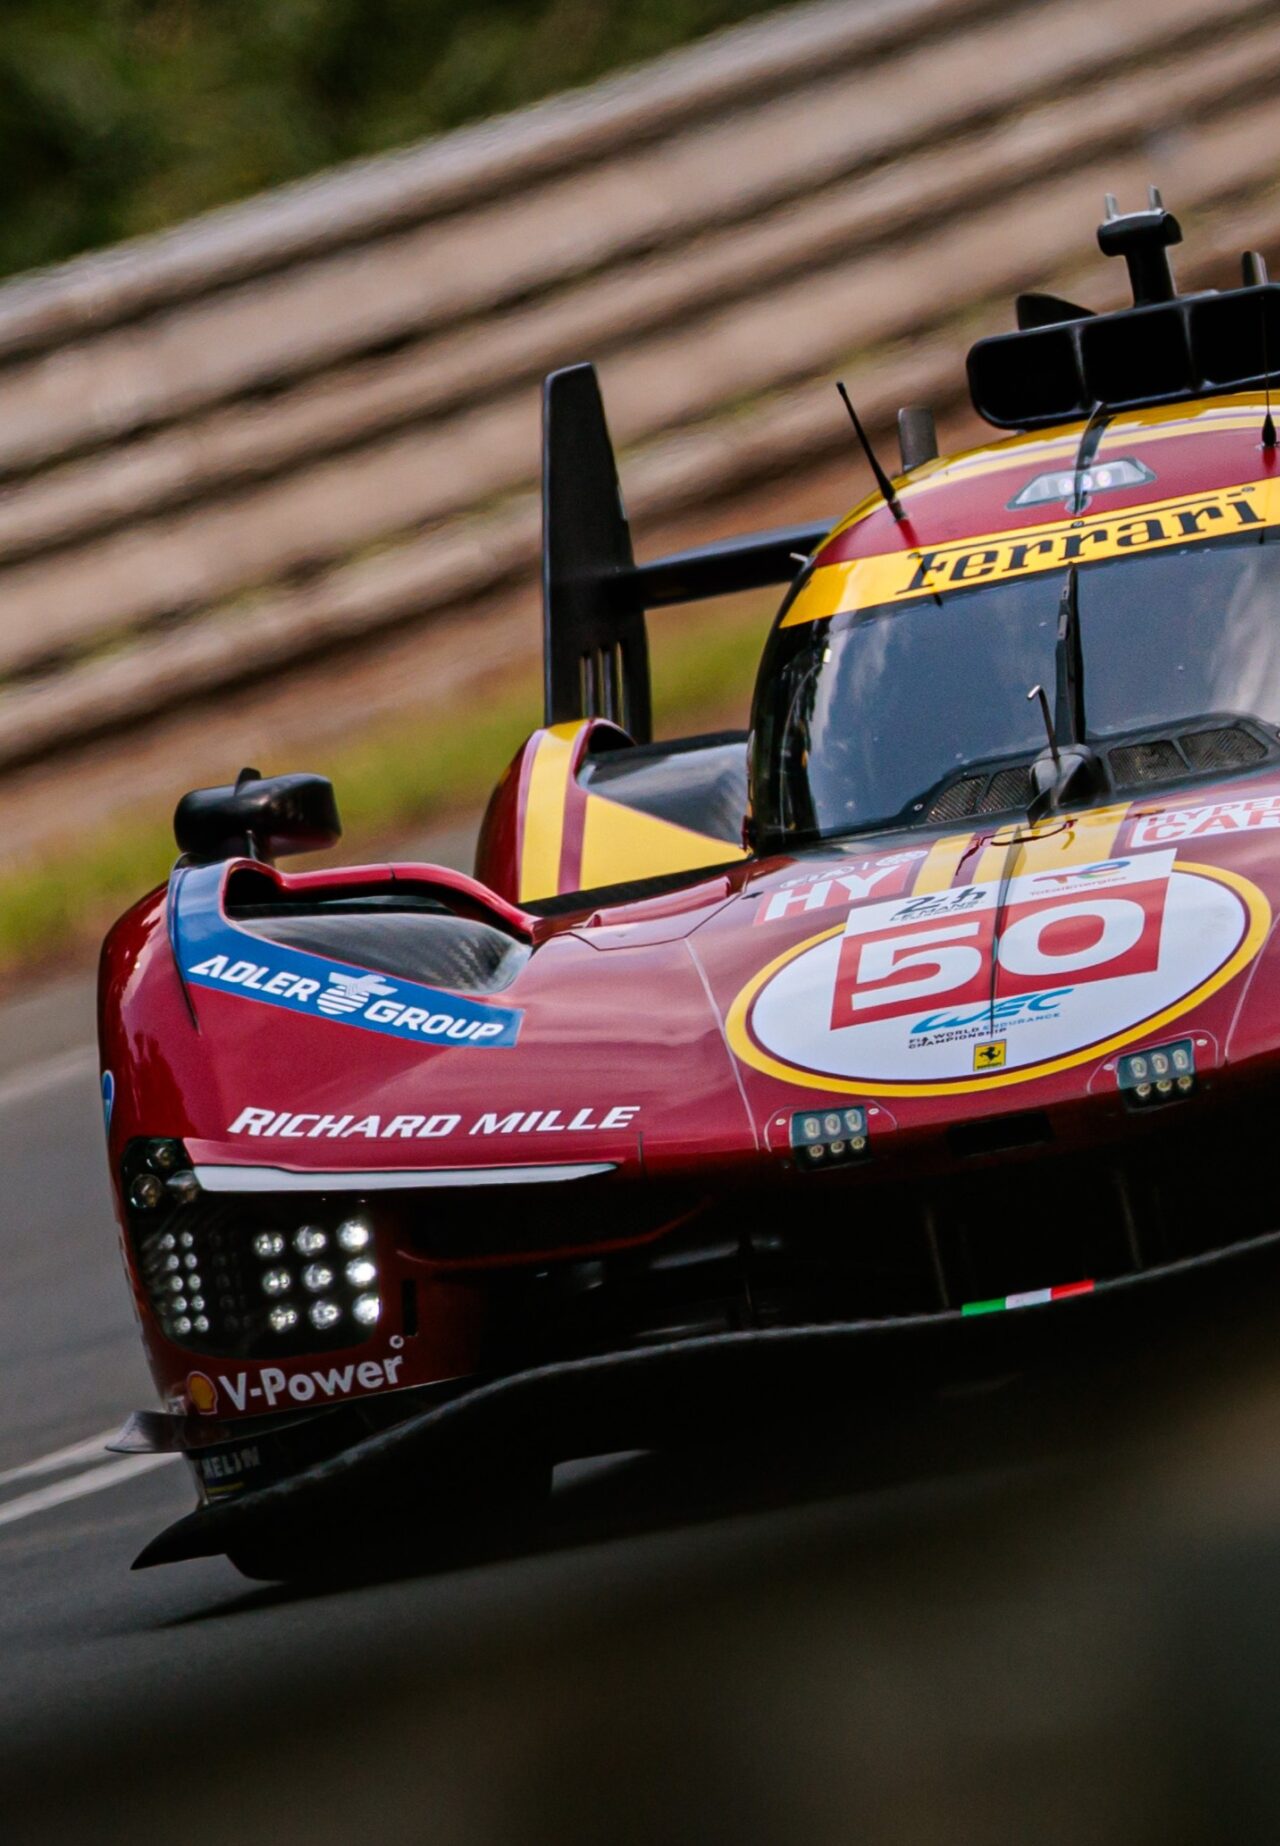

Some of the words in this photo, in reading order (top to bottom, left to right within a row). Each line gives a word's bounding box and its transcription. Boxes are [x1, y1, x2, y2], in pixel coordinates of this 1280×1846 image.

[894, 487, 1266, 596] Ferrari
[763, 866, 901, 921] HY
[850, 898, 1146, 1012] 50
[187, 954, 321, 1002] ADLER
[363, 1000, 504, 1041] GROUP
[910, 987, 1075, 1034] WEC
[908, 1027, 1008, 1050] CHAMPIONSHIP
[934, 1026, 980, 1040] WORLD
[982, 1012, 1061, 1030] ENDURANCE
[228, 1106, 461, 1138] RICHARD
[469, 1105, 641, 1135] MILLE
[219, 1355, 404, 1411] V-Power
